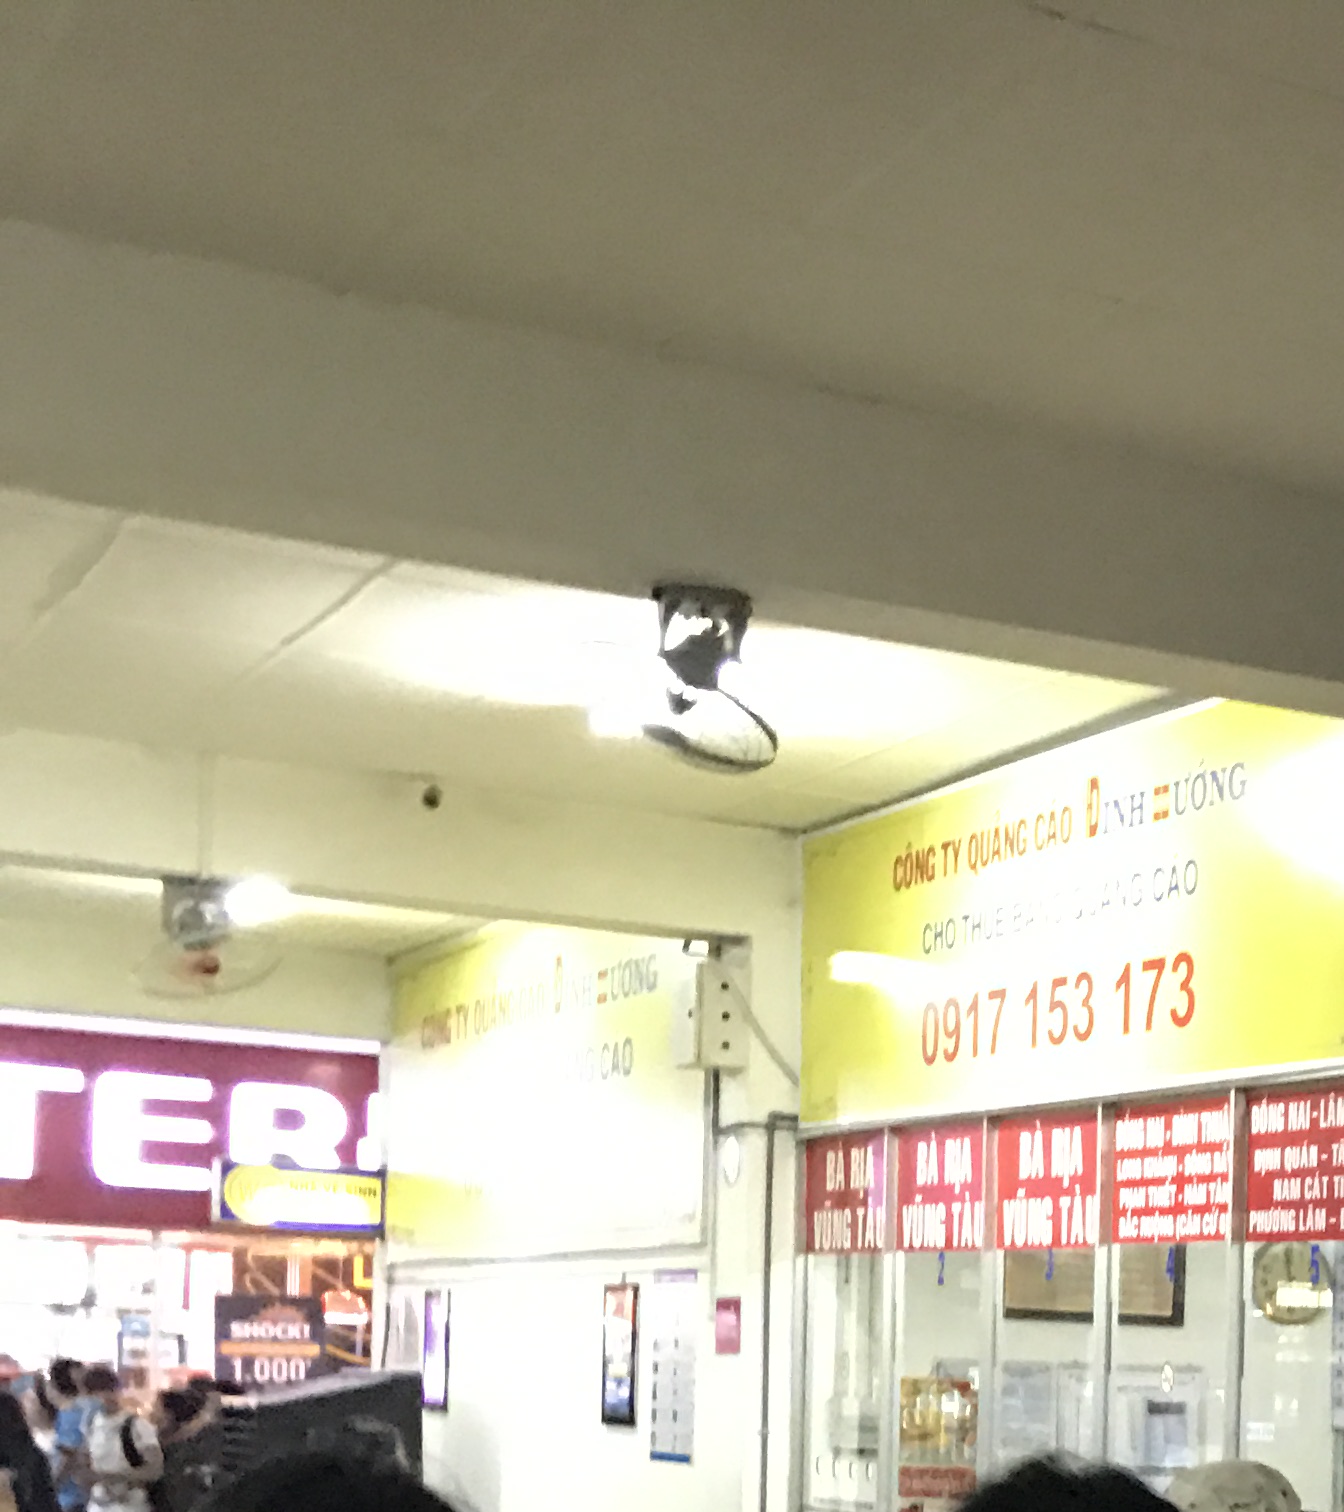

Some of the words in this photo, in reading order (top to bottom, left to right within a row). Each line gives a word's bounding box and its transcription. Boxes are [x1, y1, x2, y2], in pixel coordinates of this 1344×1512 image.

[941, 836, 961, 878] TY
[923, 917, 956, 955] CHO
[922, 988, 1007, 1066] 0917
[1025, 971, 1094, 1049] 153
[1115, 951, 1196, 1035] 173
[0, 1060, 382, 1192] TER
[1289, 1099, 1311, 1131] NAI
[1273, 1177, 1301, 1201] NAM
[1311, 1244, 1320, 1284] 5
